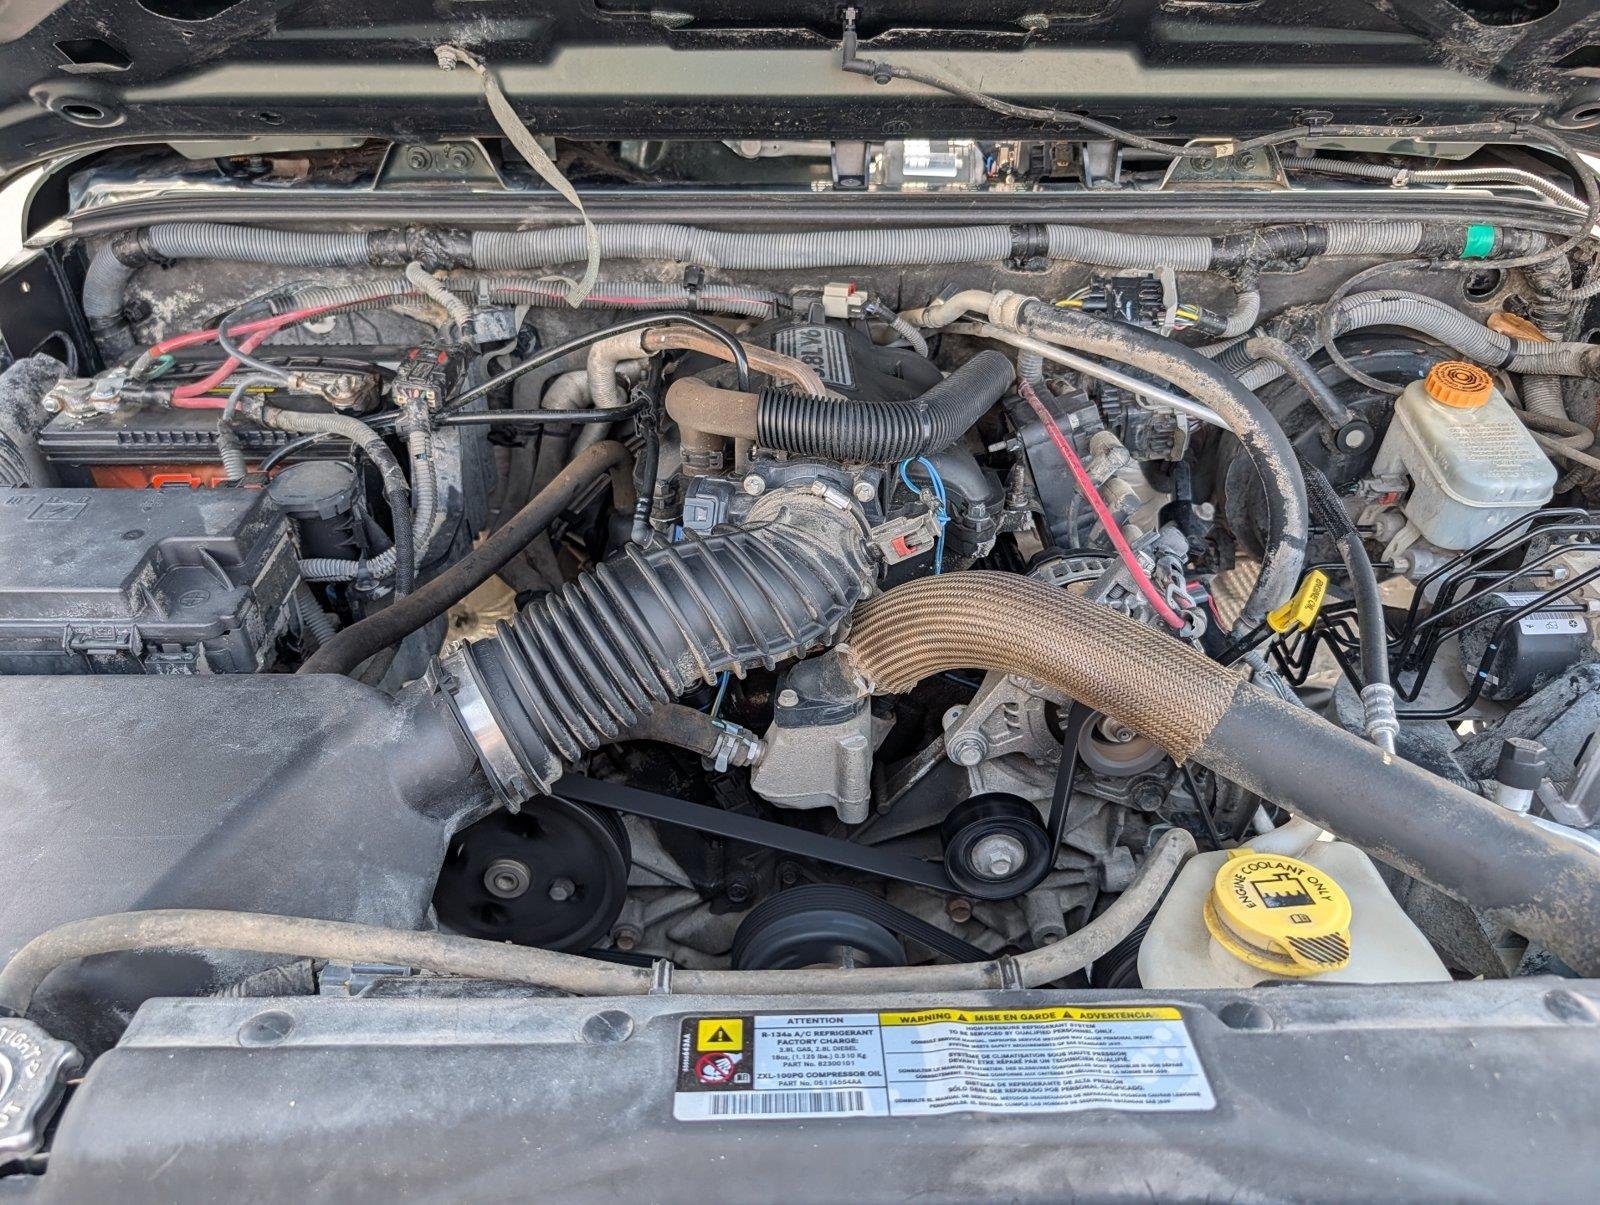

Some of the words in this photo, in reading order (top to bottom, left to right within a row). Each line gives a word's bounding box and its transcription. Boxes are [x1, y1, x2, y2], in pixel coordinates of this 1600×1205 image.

[1310, 578, 1323, 602] ENGINE
[1305, 600, 1316, 611] OIL
[1241, 862, 1305, 875] COOLANT
[1234, 874, 1256, 908] ENGINE
[1307, 876, 1335, 901] ONLY
[900, 1013, 951, 1023] WARNING
[1020, 1012, 1056, 1020] GARDE
